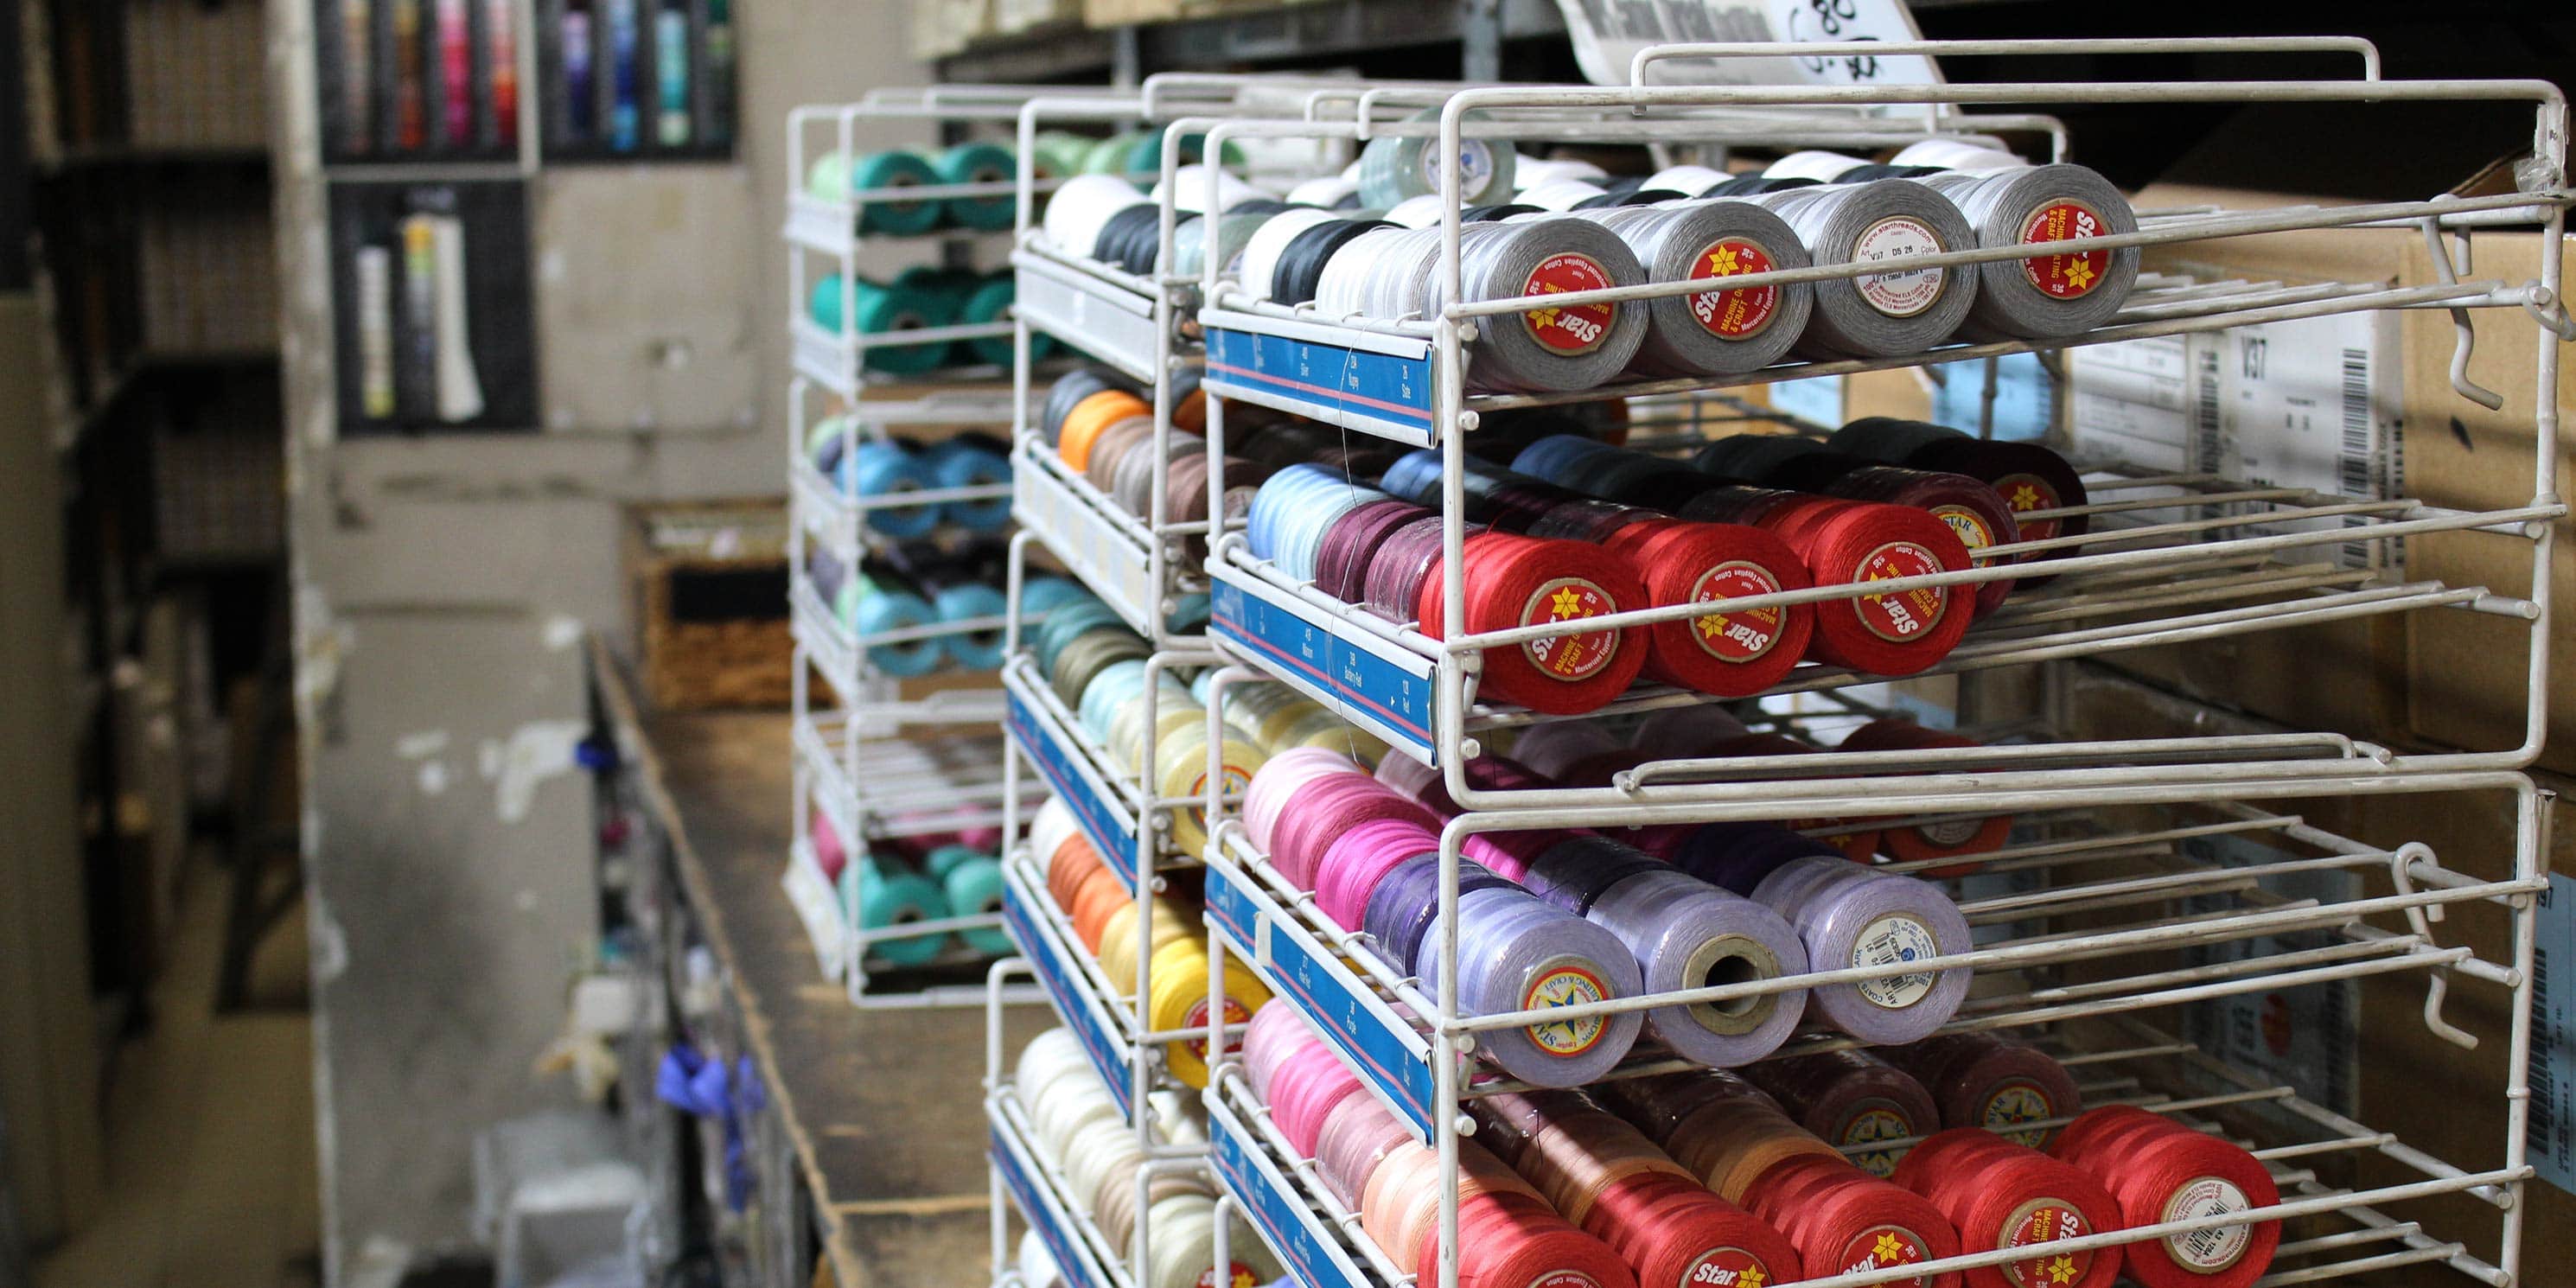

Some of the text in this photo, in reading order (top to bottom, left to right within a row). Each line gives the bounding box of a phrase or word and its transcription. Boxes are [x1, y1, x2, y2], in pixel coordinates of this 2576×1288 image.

[1864, 222, 1932, 247] www.starthreads.com
[1904, 245, 1913, 254] 26
[1695, 275, 1720, 323] Sta
[1721, 297, 1740, 331] MACHINE
[1734, 300, 1748, 325] CRAFT
[1556, 314, 1602, 342] Star
[2241, 336, 2267, 379] V37
[1881, 600, 1918, 634] Star
[1725, 623, 1769, 651] Star
[1555, 639, 1576, 672] MACHINE
[1567, 643, 1584, 667] CRAFT
[1862, 984, 1883, 1002] COATS
[1885, 990, 1897, 1004] ART
[2214, 1229, 2224, 1240] A3
[1694, 1262, 1738, 1286] Star
